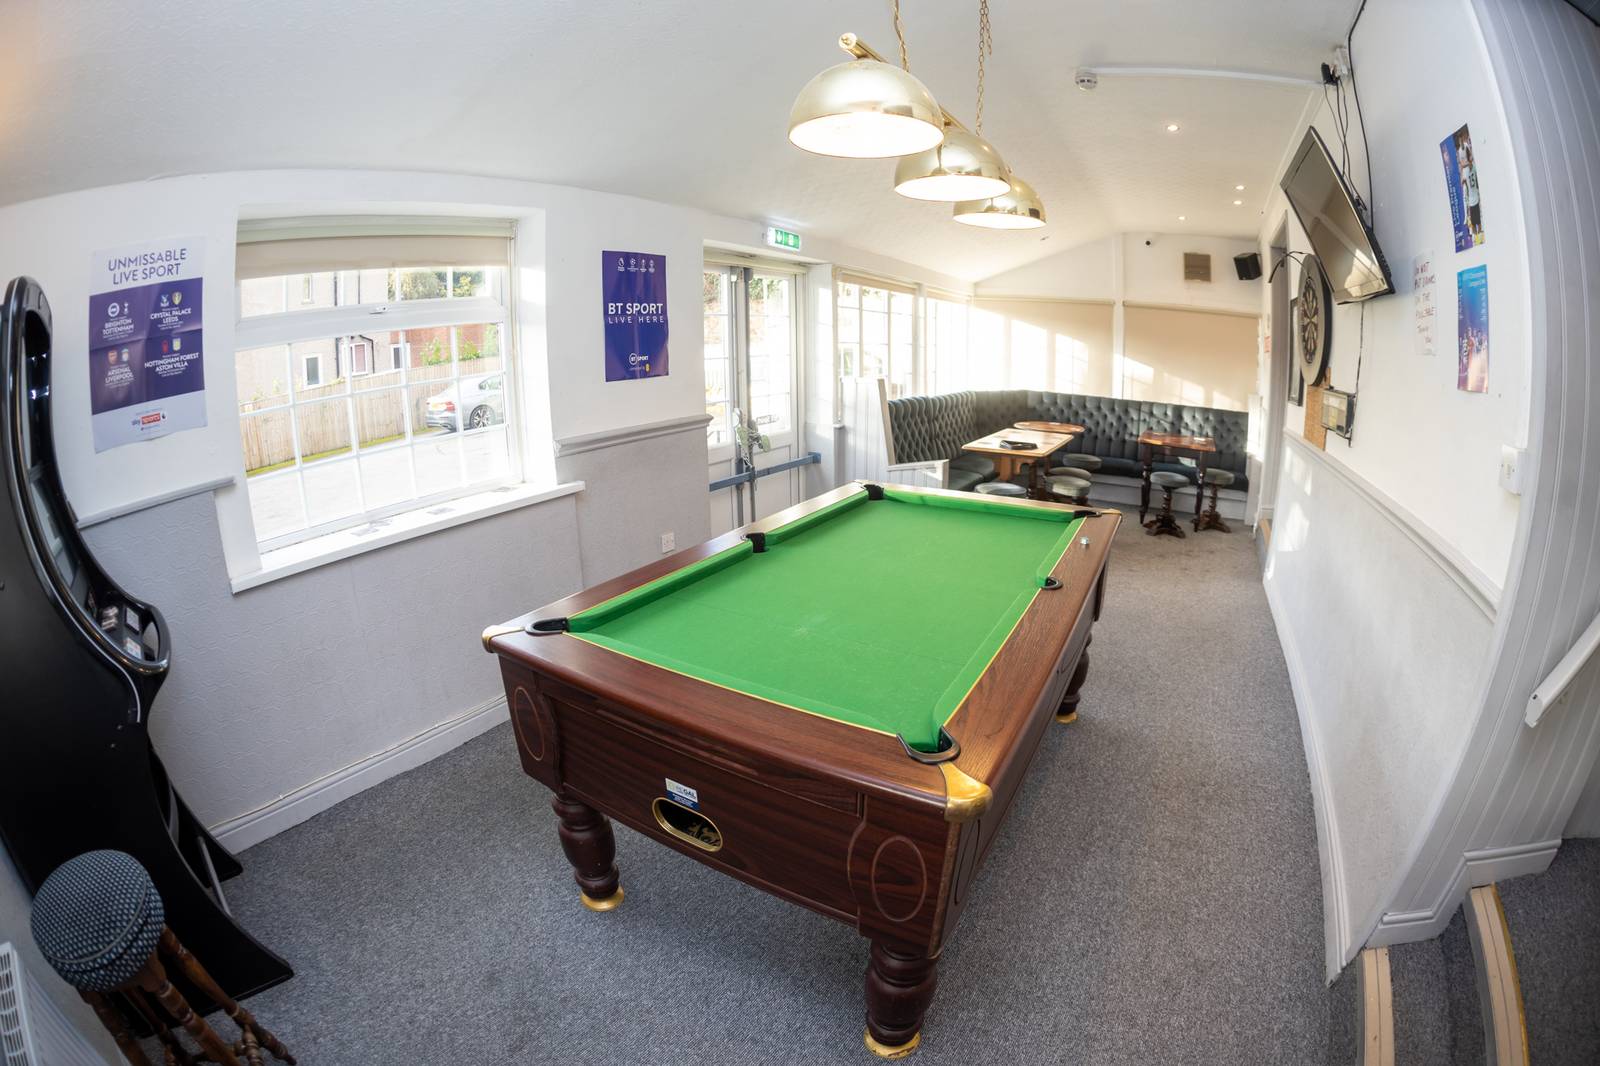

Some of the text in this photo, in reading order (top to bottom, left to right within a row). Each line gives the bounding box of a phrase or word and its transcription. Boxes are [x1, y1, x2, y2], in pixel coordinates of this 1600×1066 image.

[108, 248, 187, 271] UNMISSABLE
[113, 263, 181, 285] LIVE SPORT
[150, 311, 171, 320] CRYSTAL
[172, 307, 192, 316] PALACE
[608, 303, 663, 315] BT SPORT
[104, 318, 132, 329] BRIGHTON
[163, 316, 179, 324] LEEDS
[608, 316, 633, 324] LIVE
[102, 325, 135, 335] TOTTENHAM
[144, 357, 179, 368] NOTTINGHAM
[180, 352, 199, 361] FOREST
[155, 364, 173, 372] ASTON
[174, 361, 189, 369] VILLA
